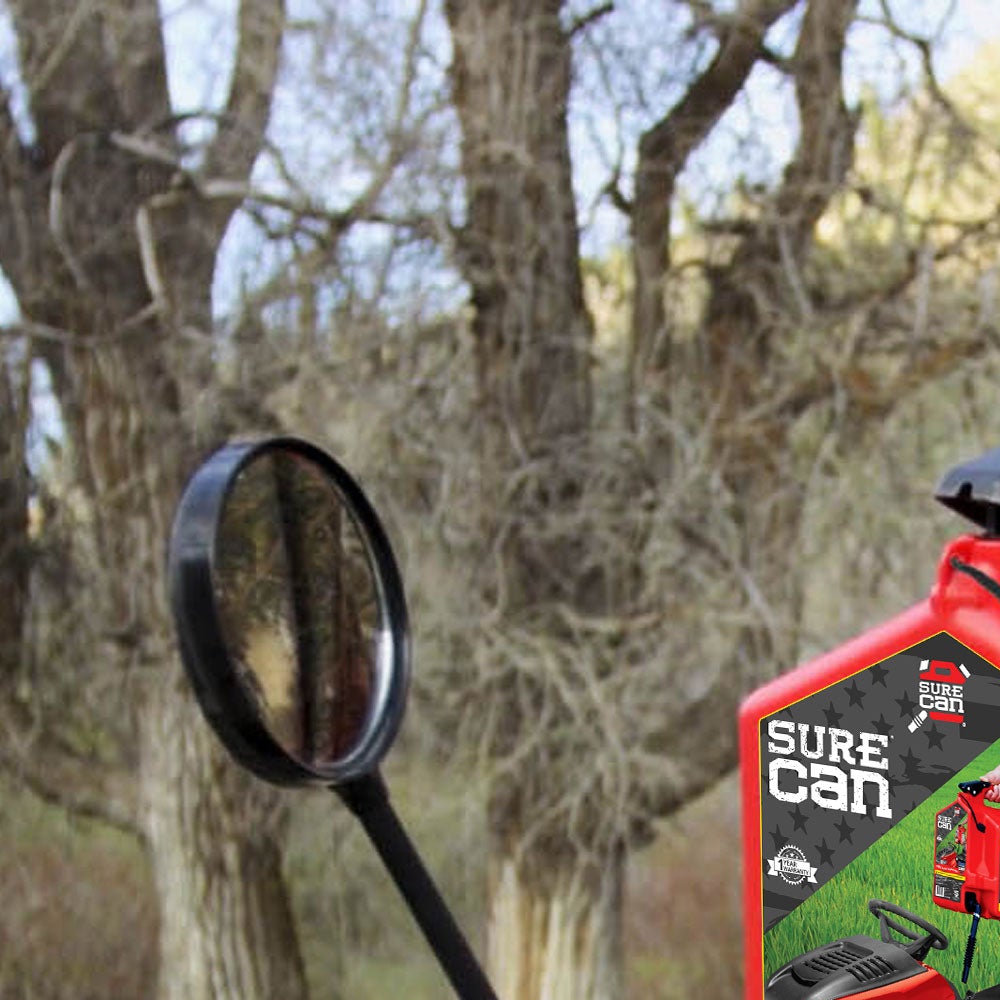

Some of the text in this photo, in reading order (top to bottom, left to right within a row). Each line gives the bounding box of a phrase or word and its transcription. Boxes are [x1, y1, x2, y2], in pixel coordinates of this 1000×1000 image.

[919, 681, 963, 698] SURE
[768, 719, 889, 770] SURE
[777, 858, 783, 871] 1
[783, 866, 809, 876] WARRANTY
